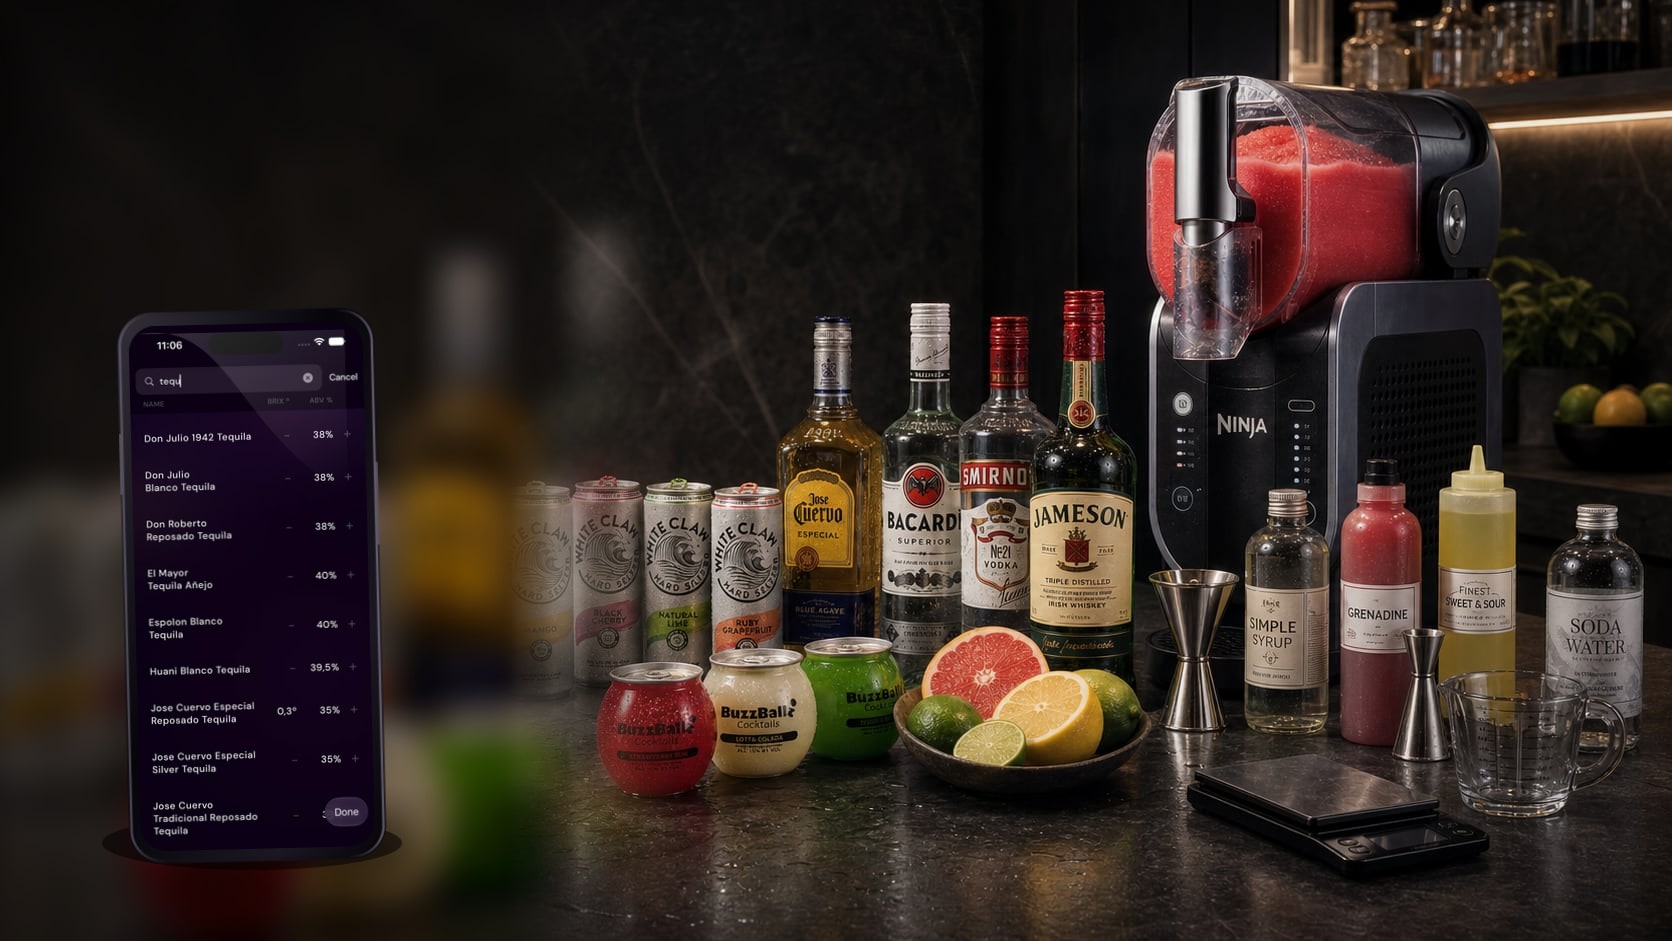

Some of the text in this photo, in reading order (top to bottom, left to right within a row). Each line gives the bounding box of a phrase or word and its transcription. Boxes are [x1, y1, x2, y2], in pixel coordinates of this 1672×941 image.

[157, 341, 182, 350] 11:06
[160, 377, 180, 388] tequ
[329, 373, 358, 382] Cancel
[1217, 413, 1267, 439] NINJA
[144, 432, 252, 444] Don Julio 1942 Tequila
[313, 430, 334, 439] 38%
[145, 470, 190, 480] Don Julio
[314, 473, 334, 482] 38%
[145, 482, 216, 494] Blanco Tequila
[808, 492, 829, 506] Jose
[793, 501, 843, 526] Cuervo
[1034, 503, 1126, 530] JAMESON
[146, 519, 207, 528] Don Roberto
[315, 522, 336, 531] 38%
[146, 531, 232, 543] Reposado Tequila
[530, 522, 570, 546] CLAW
[576, 515, 639, 564] WHITE CLAW
[797, 531, 840, 539] ESPECIAL
[646, 517, 710, 566] WHITE CLAW
[715, 522, 778, 572] WHITE CLAW
[898, 537, 951, 546] SUPERIOR
[984, 561, 1018, 569] VODKA
[147, 569, 188, 580] El Mayor
[315, 571, 337, 580] 40%
[148, 580, 213, 592] Tequila Añejo
[654, 574, 679, 592] HARD
[1045, 577, 1069, 585] TRIPLE
[723, 581, 749, 599] HARD
[1459, 586, 1490, 596] FINEST
[1445, 597, 1506, 609] SWEET & SOUR
[1347, 608, 1408, 620] GRENADINE
[149, 617, 223, 629] Espolon Blanco
[316, 620, 338, 629] 40%
[1250, 617, 1296, 633] SIMPLE
[1570, 618, 1621, 635] SODA
[149, 630, 184, 642] Tequila
[1252, 634, 1292, 648] SYRUP
[1566, 639, 1626, 654] WATER
[150, 665, 250, 677] Huani Blanco Tequila
[310, 663, 340, 673] 39,5%
[151, 701, 255, 713] Jose Cuervo Especial
[320, 706, 340, 715] 35%
[151, 715, 236, 727] Reposado Tequila
[737, 720, 780, 728] Cocktails
[152, 751, 256, 762] Jose Cuervo Especial
[321, 755, 341, 764] 35%
[152, 764, 217, 776] Silver Tequila
[153, 801, 213, 811] Jose Cuervo
[154, 812, 258, 824] Tradicional Reposado
[334, 808, 359, 817] Done
[154, 826, 188, 837] Tequila
